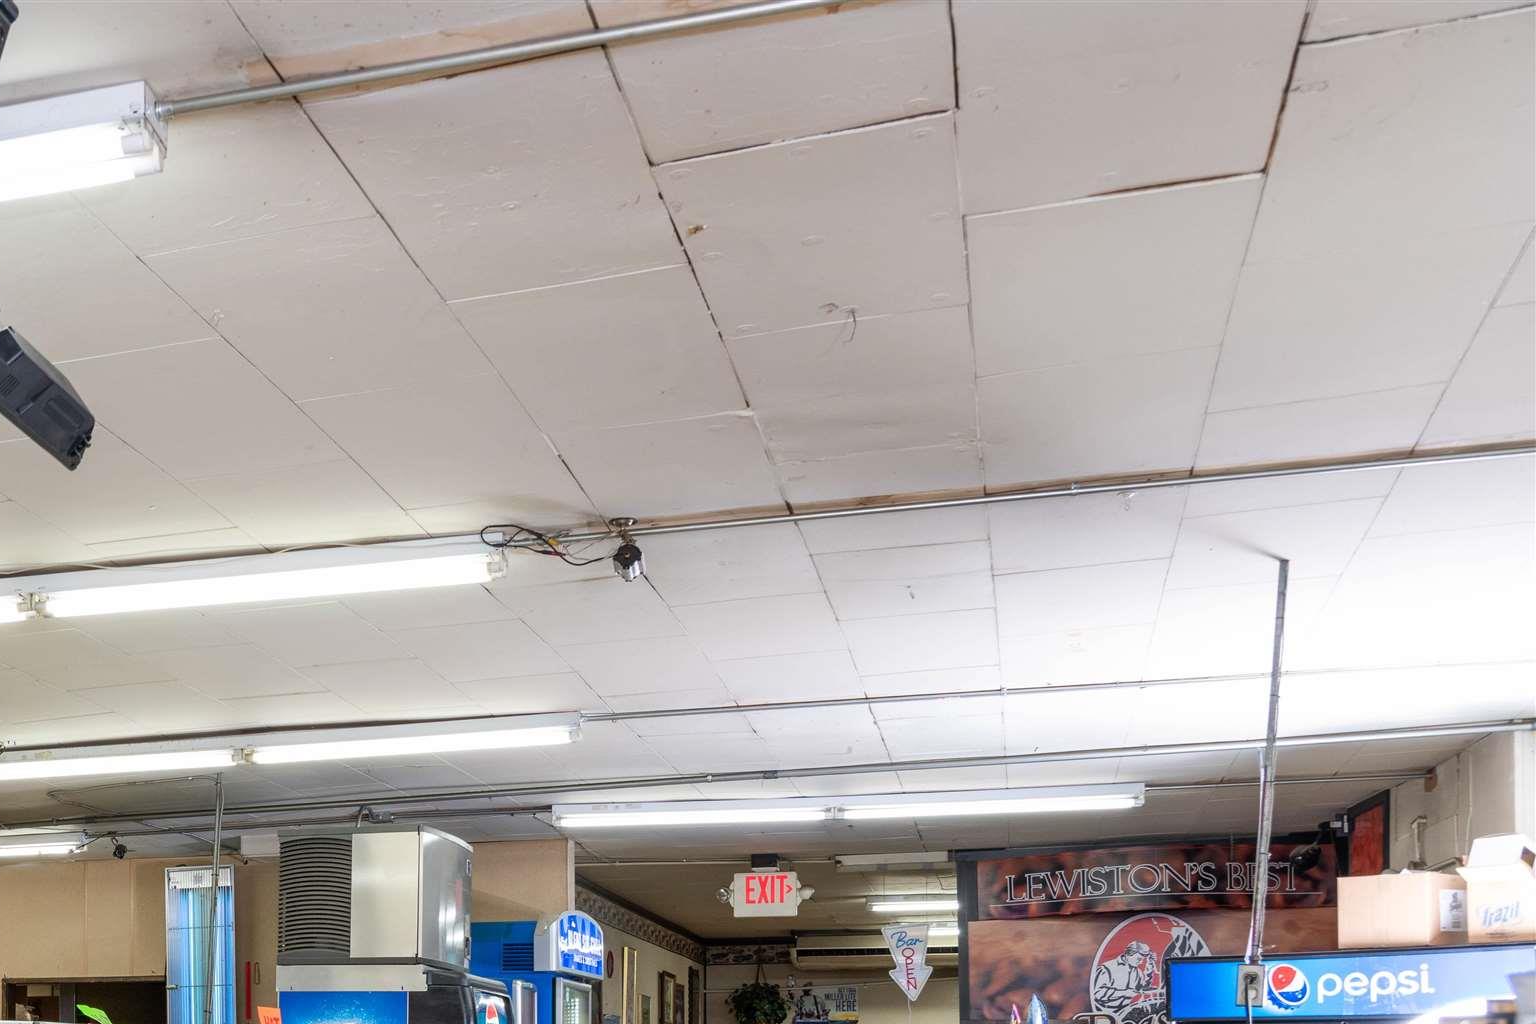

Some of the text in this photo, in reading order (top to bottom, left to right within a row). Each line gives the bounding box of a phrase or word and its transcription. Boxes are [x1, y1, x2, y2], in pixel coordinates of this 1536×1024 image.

[745, 875, 788, 905] EXIT
[1005, 862, 1296, 903] LEWISTON'S BEST
[891, 932, 924, 948] Bar
[902, 948, 917, 991] OPEN
[1317, 962, 1435, 1004] pepsi
[836, 1000, 856, 1012] HERE
